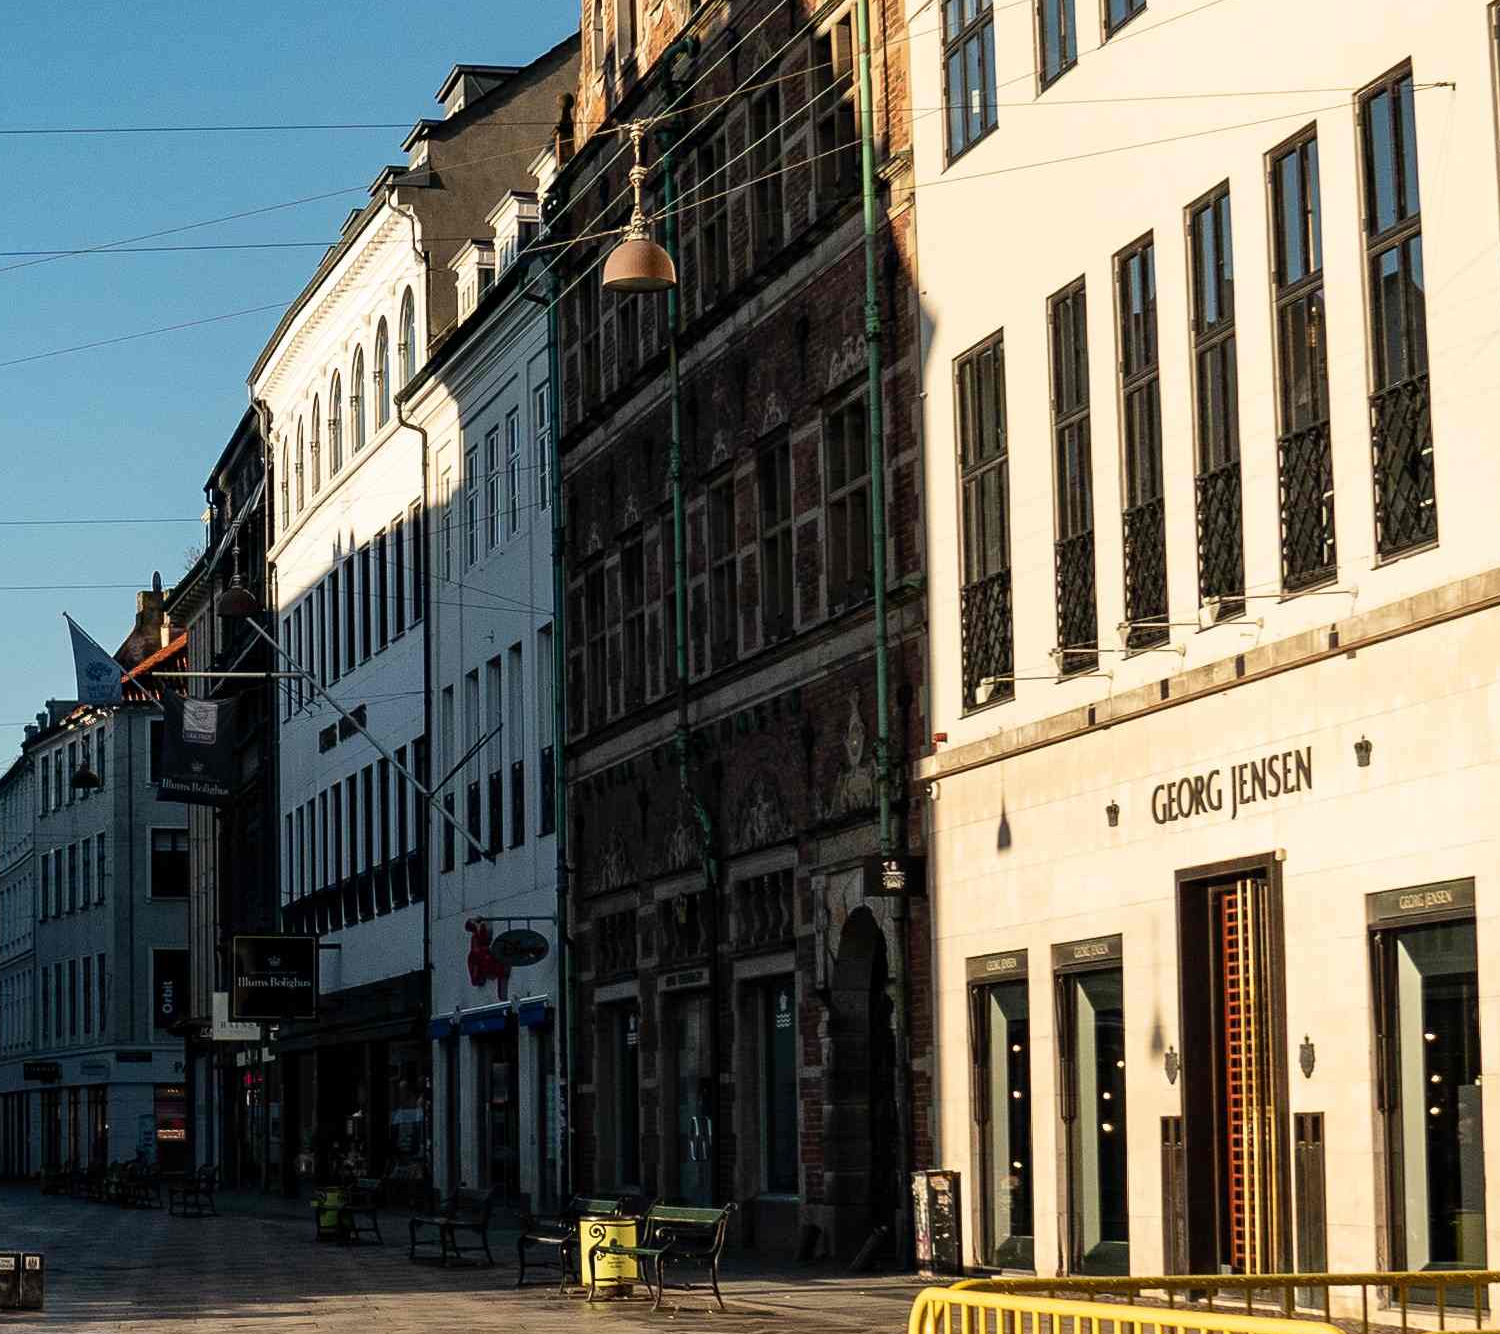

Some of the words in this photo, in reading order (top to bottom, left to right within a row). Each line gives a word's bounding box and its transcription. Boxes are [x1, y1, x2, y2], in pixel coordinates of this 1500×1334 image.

[1151, 769, 1223, 824] GEORG
[1230, 746, 1312, 820] JENSEN
[1399, 892, 1424, 910] GEORG
[1425, 889, 1452, 907] JENSEN
[238, 975, 269, 988] Illums
[161, 979, 174, 1015] Orbit
